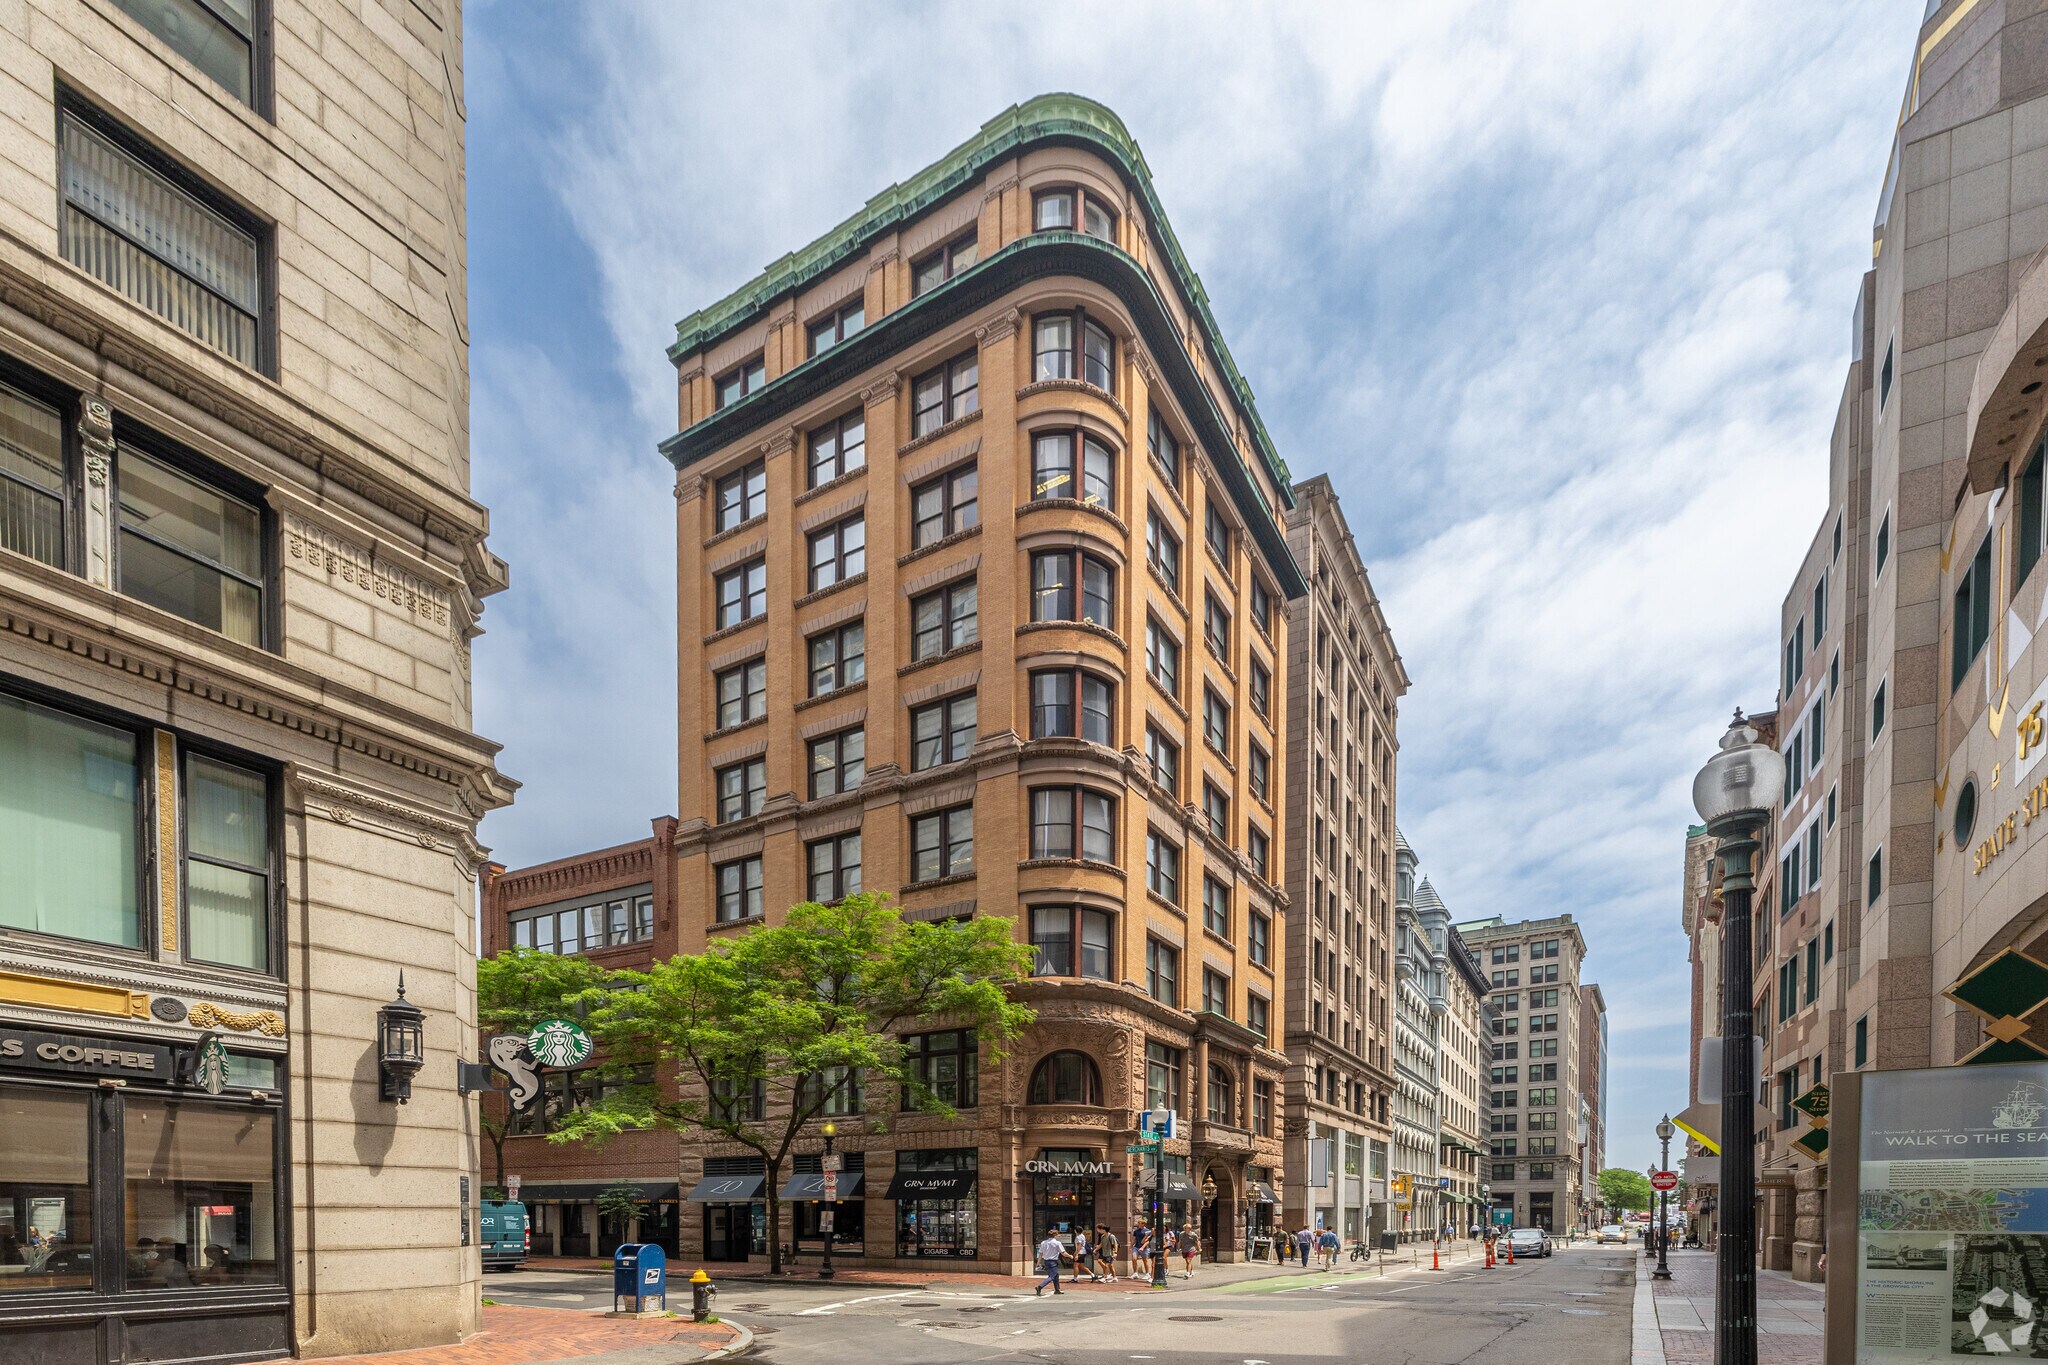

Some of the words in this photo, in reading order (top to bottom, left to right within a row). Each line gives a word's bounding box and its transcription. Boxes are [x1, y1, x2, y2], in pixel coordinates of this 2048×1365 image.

[1973, 810, 2018, 876] STATE
[0, 1038, 25, 1056] S
[36, 1042, 155, 1070] COFFEE
[1810, 1096, 1829, 1107] 75
[1885, 1135, 1938, 1146] WALK
[1942, 1134, 1968, 1145] TO
[1972, 1133, 2010, 1144] THE
[2016, 1132, 2048, 1143] SEA
[1025, 1160, 1060, 1173] GRN
[1064, 1160, 1114, 1174] MVMT
[904, 1180, 925, 1188] GRN
[927, 1179, 959, 1187] MVMT
